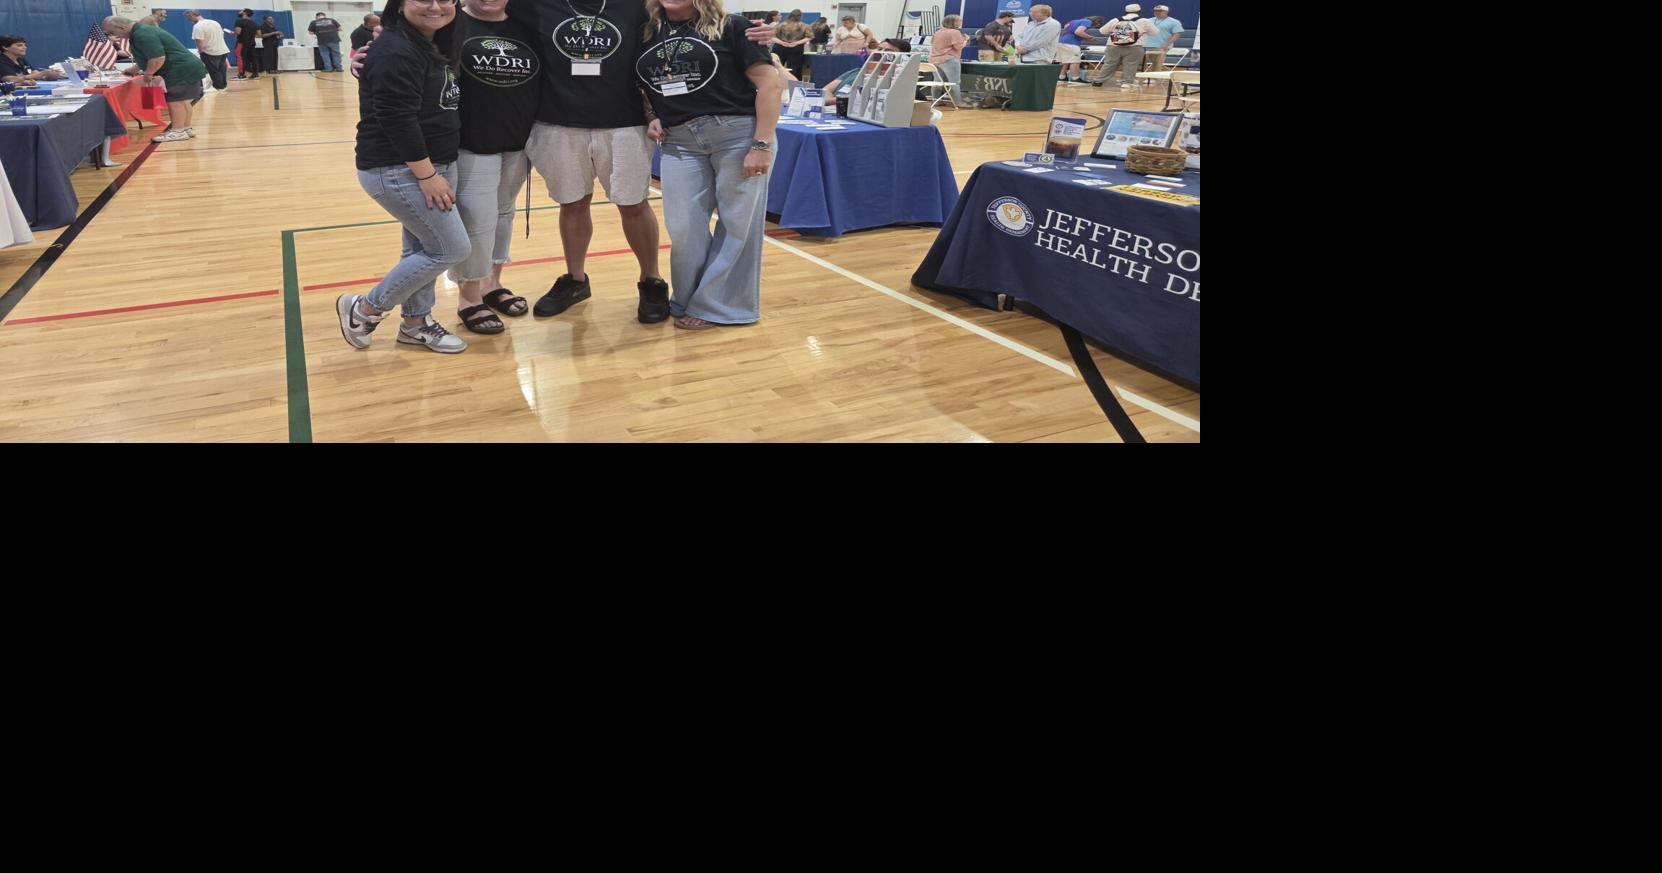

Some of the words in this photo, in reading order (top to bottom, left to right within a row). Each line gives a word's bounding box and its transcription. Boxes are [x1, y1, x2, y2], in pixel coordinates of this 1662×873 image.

[564, 36, 611, 46] WDRI
[471, 54, 531, 68] WDRI
[1034, 230, 1152, 284] HEALTH
[1039, 208, 1200, 272] JEFFERSO
